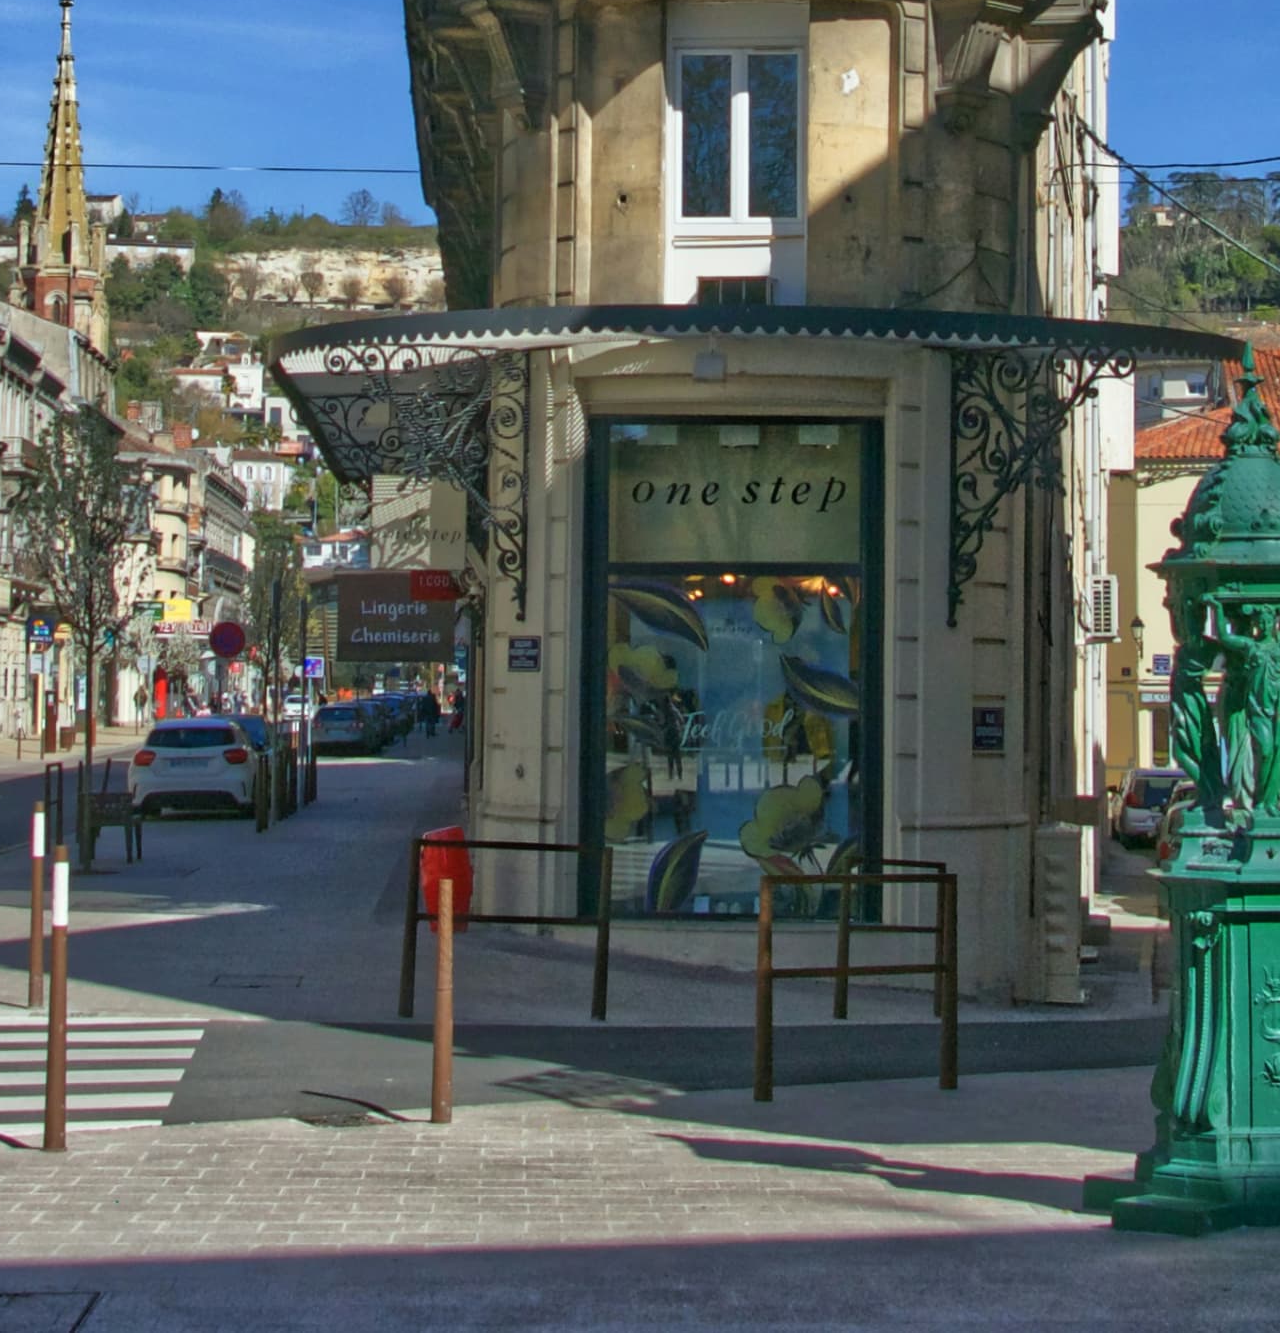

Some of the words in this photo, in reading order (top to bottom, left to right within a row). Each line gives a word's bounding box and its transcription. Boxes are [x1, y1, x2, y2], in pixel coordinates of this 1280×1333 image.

[631, 479, 720, 506] one
[740, 475, 847, 513] step
[360, 600, 428, 622] Lingerie
[350, 627, 441, 644] Chemiserie
